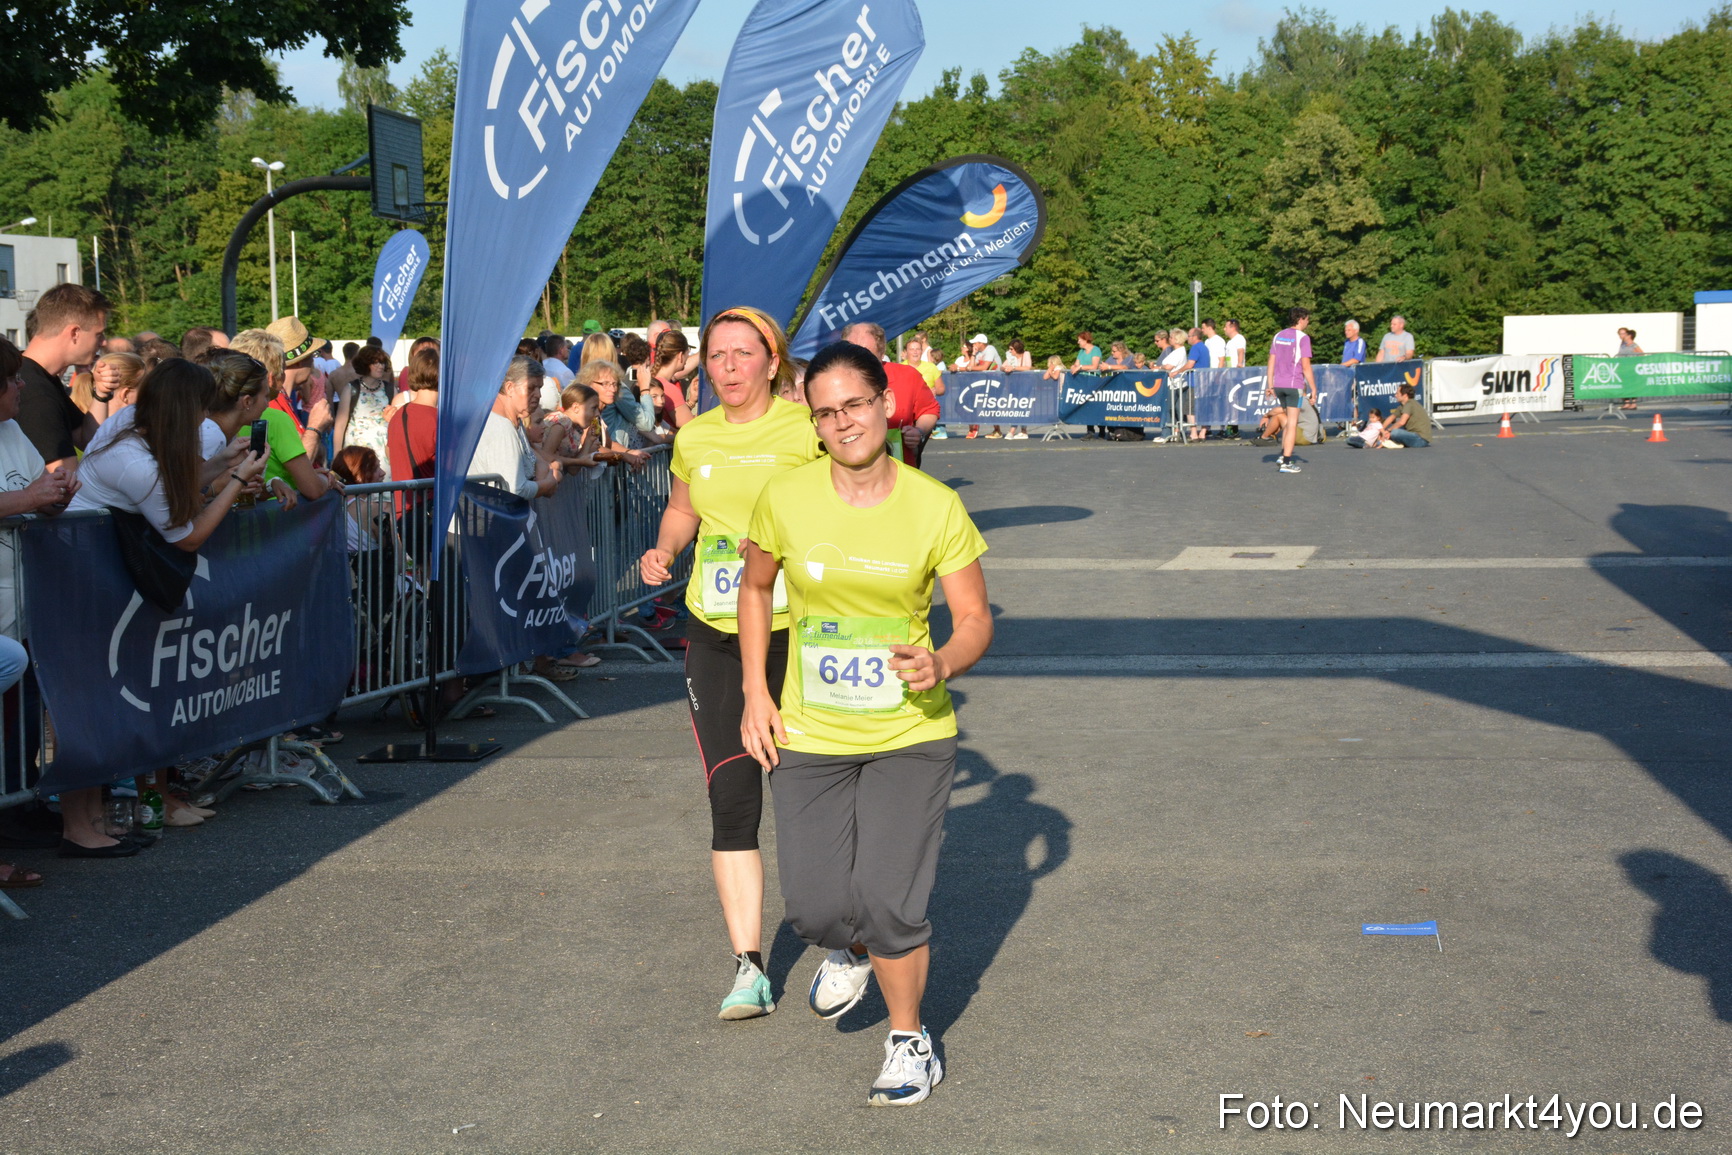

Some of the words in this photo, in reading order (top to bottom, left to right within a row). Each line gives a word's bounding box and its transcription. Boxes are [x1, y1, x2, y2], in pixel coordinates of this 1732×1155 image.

[762, 4, 876, 209] Fischer
[921, 263, 958, 289] Druck
[960, 250, 984, 267] und
[985, 221, 1030, 255] Medien
[386, 244, 417, 310] Fischer
[397, 256, 421, 310] AUTOMOBILE
[819, 232, 976, 331] Frischmann
[1582, 362, 1622, 384] AOK
[1635, 360, 1722, 375] GESUNDHEIT
[1688, 373, 1731, 384] HÄNDEN
[1482, 370, 1531, 395] swn
[973, 392, 1036, 409] Fischer
[1106, 403, 1123, 411] Druck
[1124, 403, 1136, 411] und
[1137, 403, 1161, 412] Medien
[151, 603, 291, 688] Fischer
[814, 631, 852, 640] firmenlauf
[819, 655, 884, 687] 643
[171, 670, 281, 727] AUTOMOBILE
[830, 692, 853, 701] Melanie
